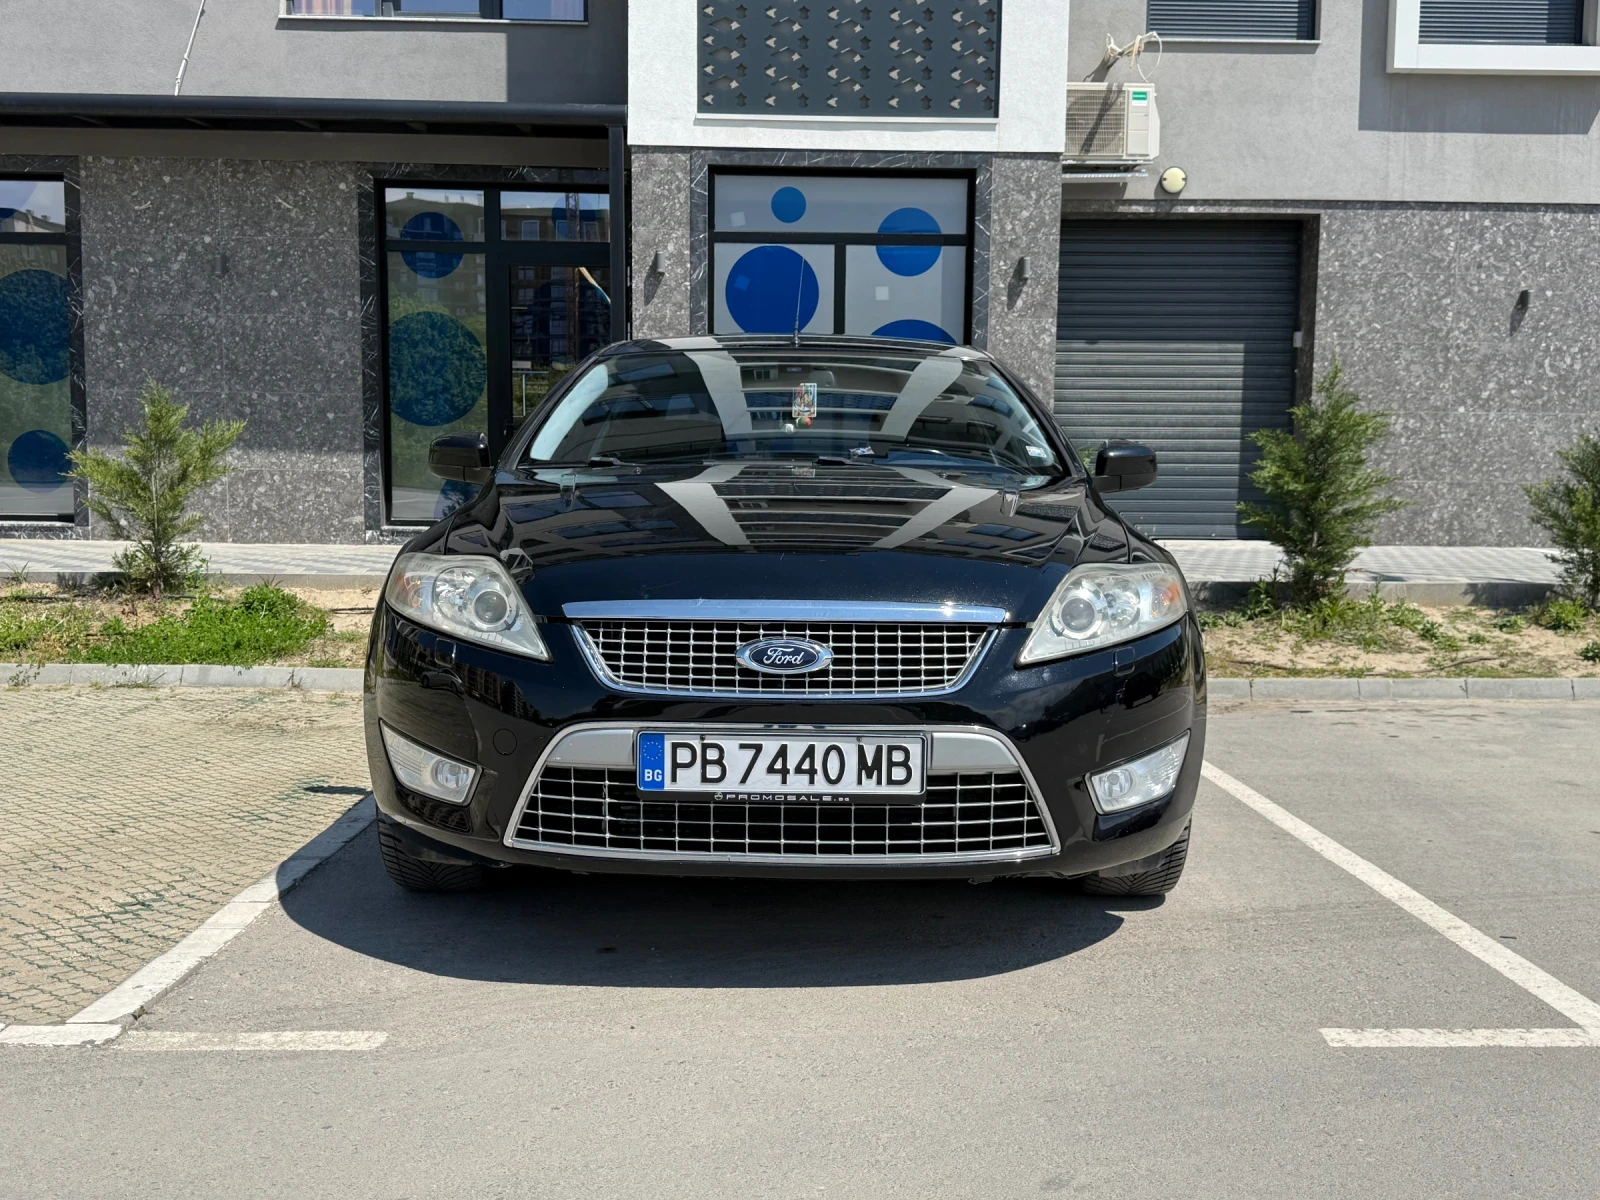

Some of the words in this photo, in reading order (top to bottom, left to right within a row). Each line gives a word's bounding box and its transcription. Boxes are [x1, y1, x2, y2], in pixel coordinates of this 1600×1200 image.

[763, 647, 805, 664] Ford
[671, 742, 727, 783] PB
[738, 743, 846, 785] 7440
[857, 744, 913, 786] MB
[644, 769, 662, 782] BG
